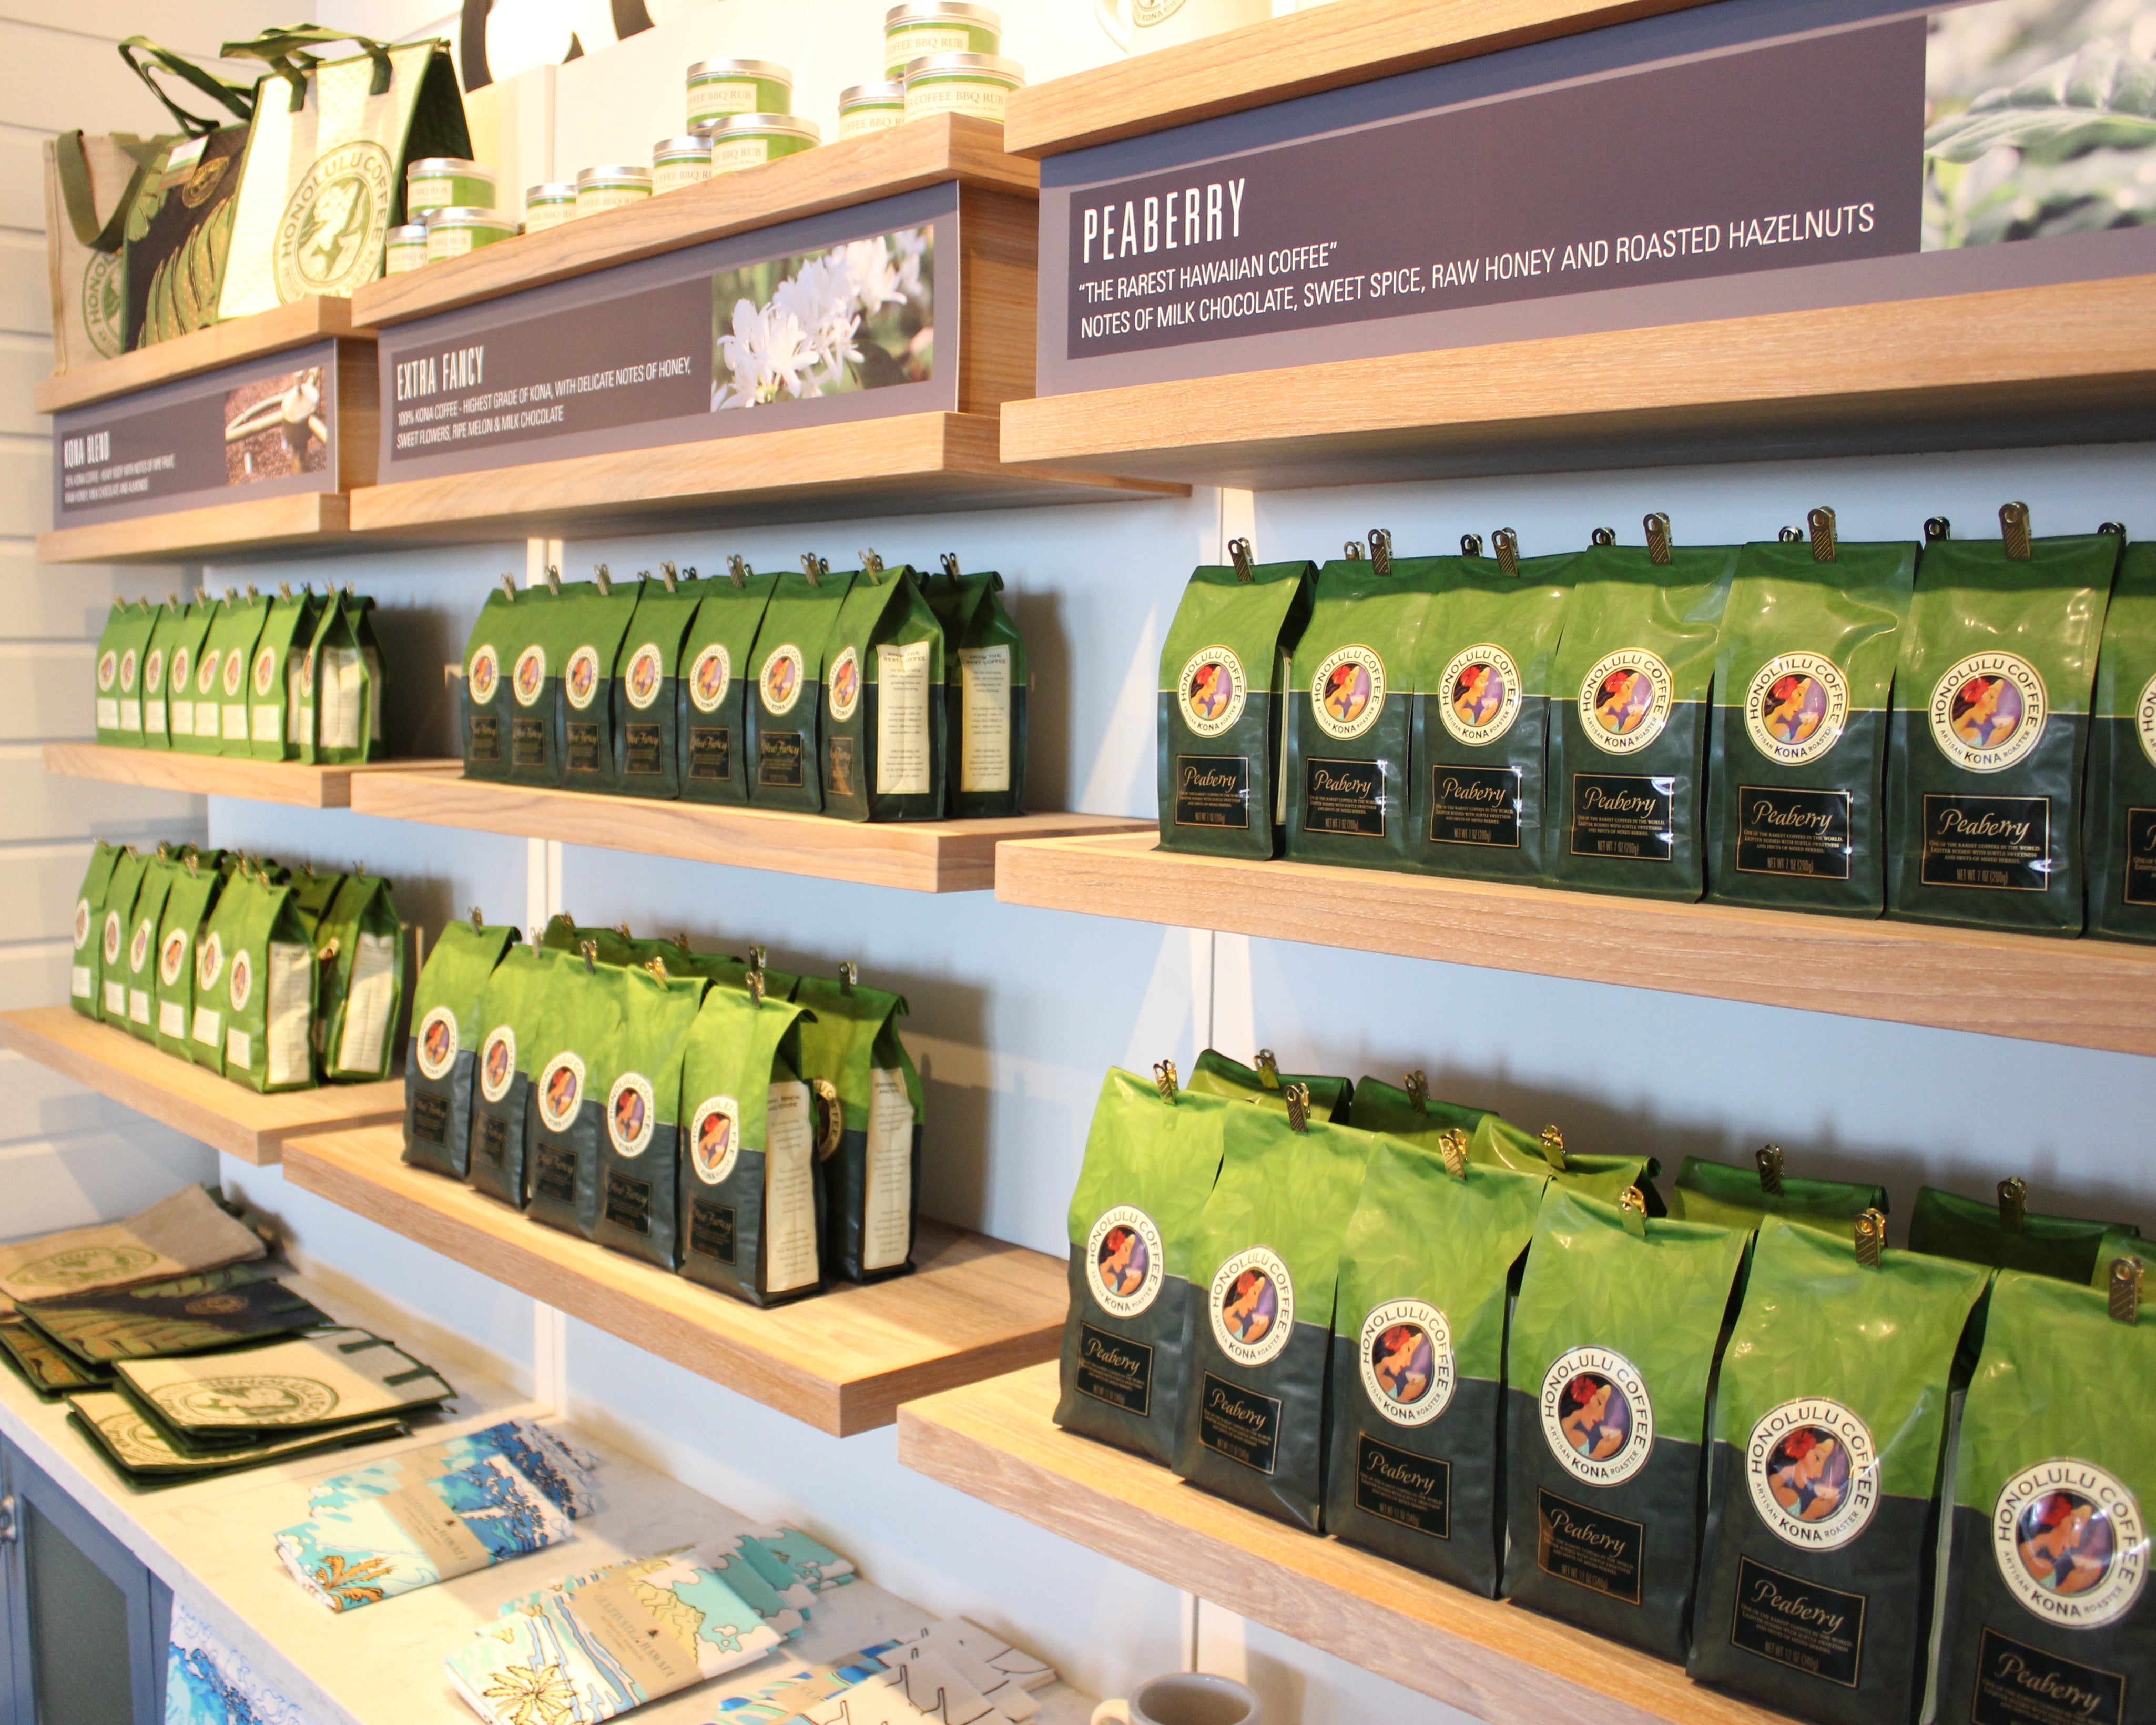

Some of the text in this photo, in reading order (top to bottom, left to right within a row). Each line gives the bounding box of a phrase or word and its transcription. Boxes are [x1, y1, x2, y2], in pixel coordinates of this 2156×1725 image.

[915, 37, 938, 48] BBQ
[941, 37, 963, 48] RUB
[708, 91, 727, 101] BBQ
[730, 90, 752, 99] RUB
[914, 90, 953, 104] COFFEE
[956, 92, 979, 103] BBQ
[983, 93, 1004, 105] RUB
[869, 117, 891, 129] BBQ
[679, 170, 699, 180] BBQ
[722, 148, 761, 159] BBQ RUB
[281, 151, 363, 258] HONOLULU
[363, 156, 389, 243] COFFEE
[602, 197, 621, 206] BBQ
[1083, 178, 1245, 264] PEABERRY
[1081, 202, 1874, 339] NOTES OF MILK CHOCOLATE, SWEET SPICE, RAW HONEY AND ROASTED HAZELNUTS
[1118, 268, 1176, 299] RAREST
[1180, 253, 1263, 289] HAWAIIAN
[397, 345, 484, 401] EXTRA FANCY
[398, 410, 414, 427] 100%
[415, 405, 434, 423] KONA
[435, 400, 459, 420] COFFEE
[463, 393, 493, 414] HIGHEST
[493, 389, 518, 409] GRADE
[519, 387, 529, 403] OF
[530, 383, 553, 403] KONA,
[555, 378, 576, 397] WITH
[577, 370, 615, 393] DELICATE
[616, 364, 645, 386] NOTES
[646, 362, 657, 381] OF
[658, 356, 692, 378] HONEY,
[64, 430, 110, 469] KONA BLEND
[397, 405, 565, 450] SWEET FLOWERS, RIPE MELON & MILK CHOCOLATE
[762, 648, 790, 687] HONOLULU
[1181, 651, 1242, 703] HONOLULU COFFEE
[1315, 650, 1382, 704] HONOLULU COFFEE
[1442, 651, 1516, 712] HONOLULU COFFEE
[1583, 654, 1668, 716] HONOLULU COFFEE
[1750, 658, 1843, 724] HONOLULU COFFEE
[1936, 658, 2039, 728] HONOLULU COFFEE
[1184, 706, 1236, 732] ARTISAN KONA ROASTER
[1317, 707, 1375, 734] ARTISAN KONA ROASTER
[1446, 711, 1510, 739] ARTISAN KONA ROASTER
[1587, 717, 1657, 748] ARTISAN KONA ROASTER
[1754, 725, 1833, 758] ARTISAN KONA ROASTER
[1940, 729, 2031, 765] ARTISAN KONA ROASTER
[1184, 766, 1237, 793] Peaberry
[1313, 770, 1372, 799] Peaberry
[1441, 777, 1506, 808] Peaberry
[1583, 787, 1656, 819] Peaberry
[1751, 800, 1833, 836] Peaberry
[1937, 809, 2031, 845] Peaberry
[1767, 857, 1776, 869] NET
[1777, 858, 1784, 869] WT
[1790, 858, 1796, 870] OZ
[1090, 1210, 1161, 1288] HONOLULU COFFEE
[1091, 1271, 1152, 1311] ARTISAN KONA ROASTER
[1212, 1252, 1290, 1333] HONOLULU COFFEE
[1086, 1338, 1140, 1376] Peaberry
[1214, 1314, 1282, 1359] ARTISAN KONA ROASTER
[1362, 1306, 1450, 1392] HONOLULU COFFEE
[1210, 1388, 1266, 1432] Peaberry
[1366, 1371, 1442, 1420] ARTISAN KONA ROASTER
[1545, 1354, 1649, 1449] HONOLULU COFFEE
[1368, 1450, 1435, 1494] Peaberry
[1549, 1425, 1639, 1479] ARTISAN KONA ROASTER
[1752, 1406, 1872, 1509] HONOLULU COFFEE
[1551, 1508, 1626, 1557] Peaberry
[1755, 1482, 1860, 1541] ARTISAN KONA ROASTER
[1999, 1468, 2139, 1584] HONOLULU COFFEE
[2003, 1551, 2124, 1618] ARTISAN KONA ROASTER
[1754, 1580, 1845, 1635] Peaberry
[1994, 1652, 2102, 1716] Peaberry
